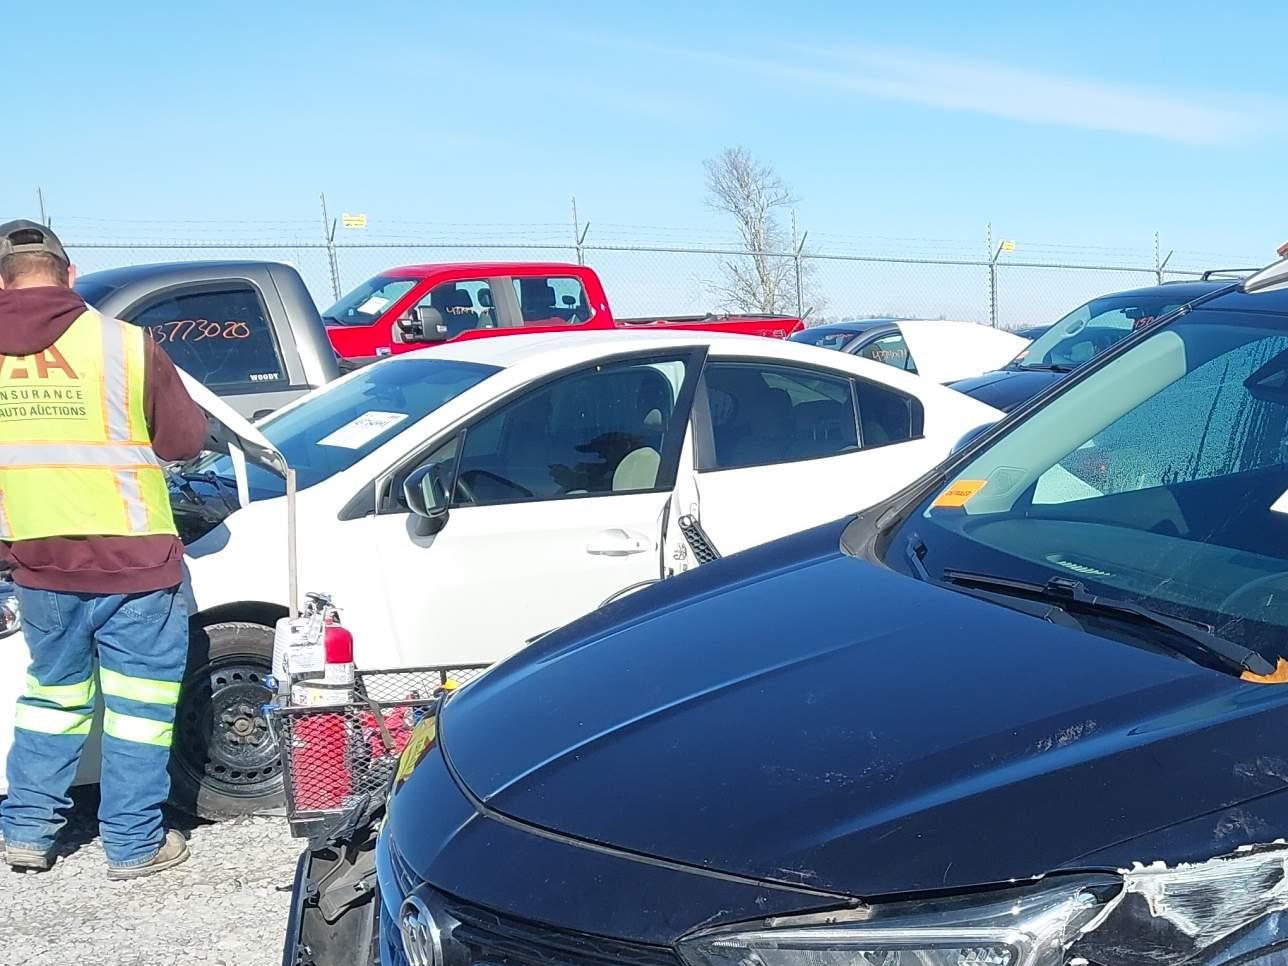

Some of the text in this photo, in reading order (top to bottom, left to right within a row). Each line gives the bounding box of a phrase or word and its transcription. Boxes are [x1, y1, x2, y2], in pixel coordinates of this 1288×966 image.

[0, 390, 83, 400] NSURANCE
[0, 405, 86, 417] AUTO AUCTIONS
